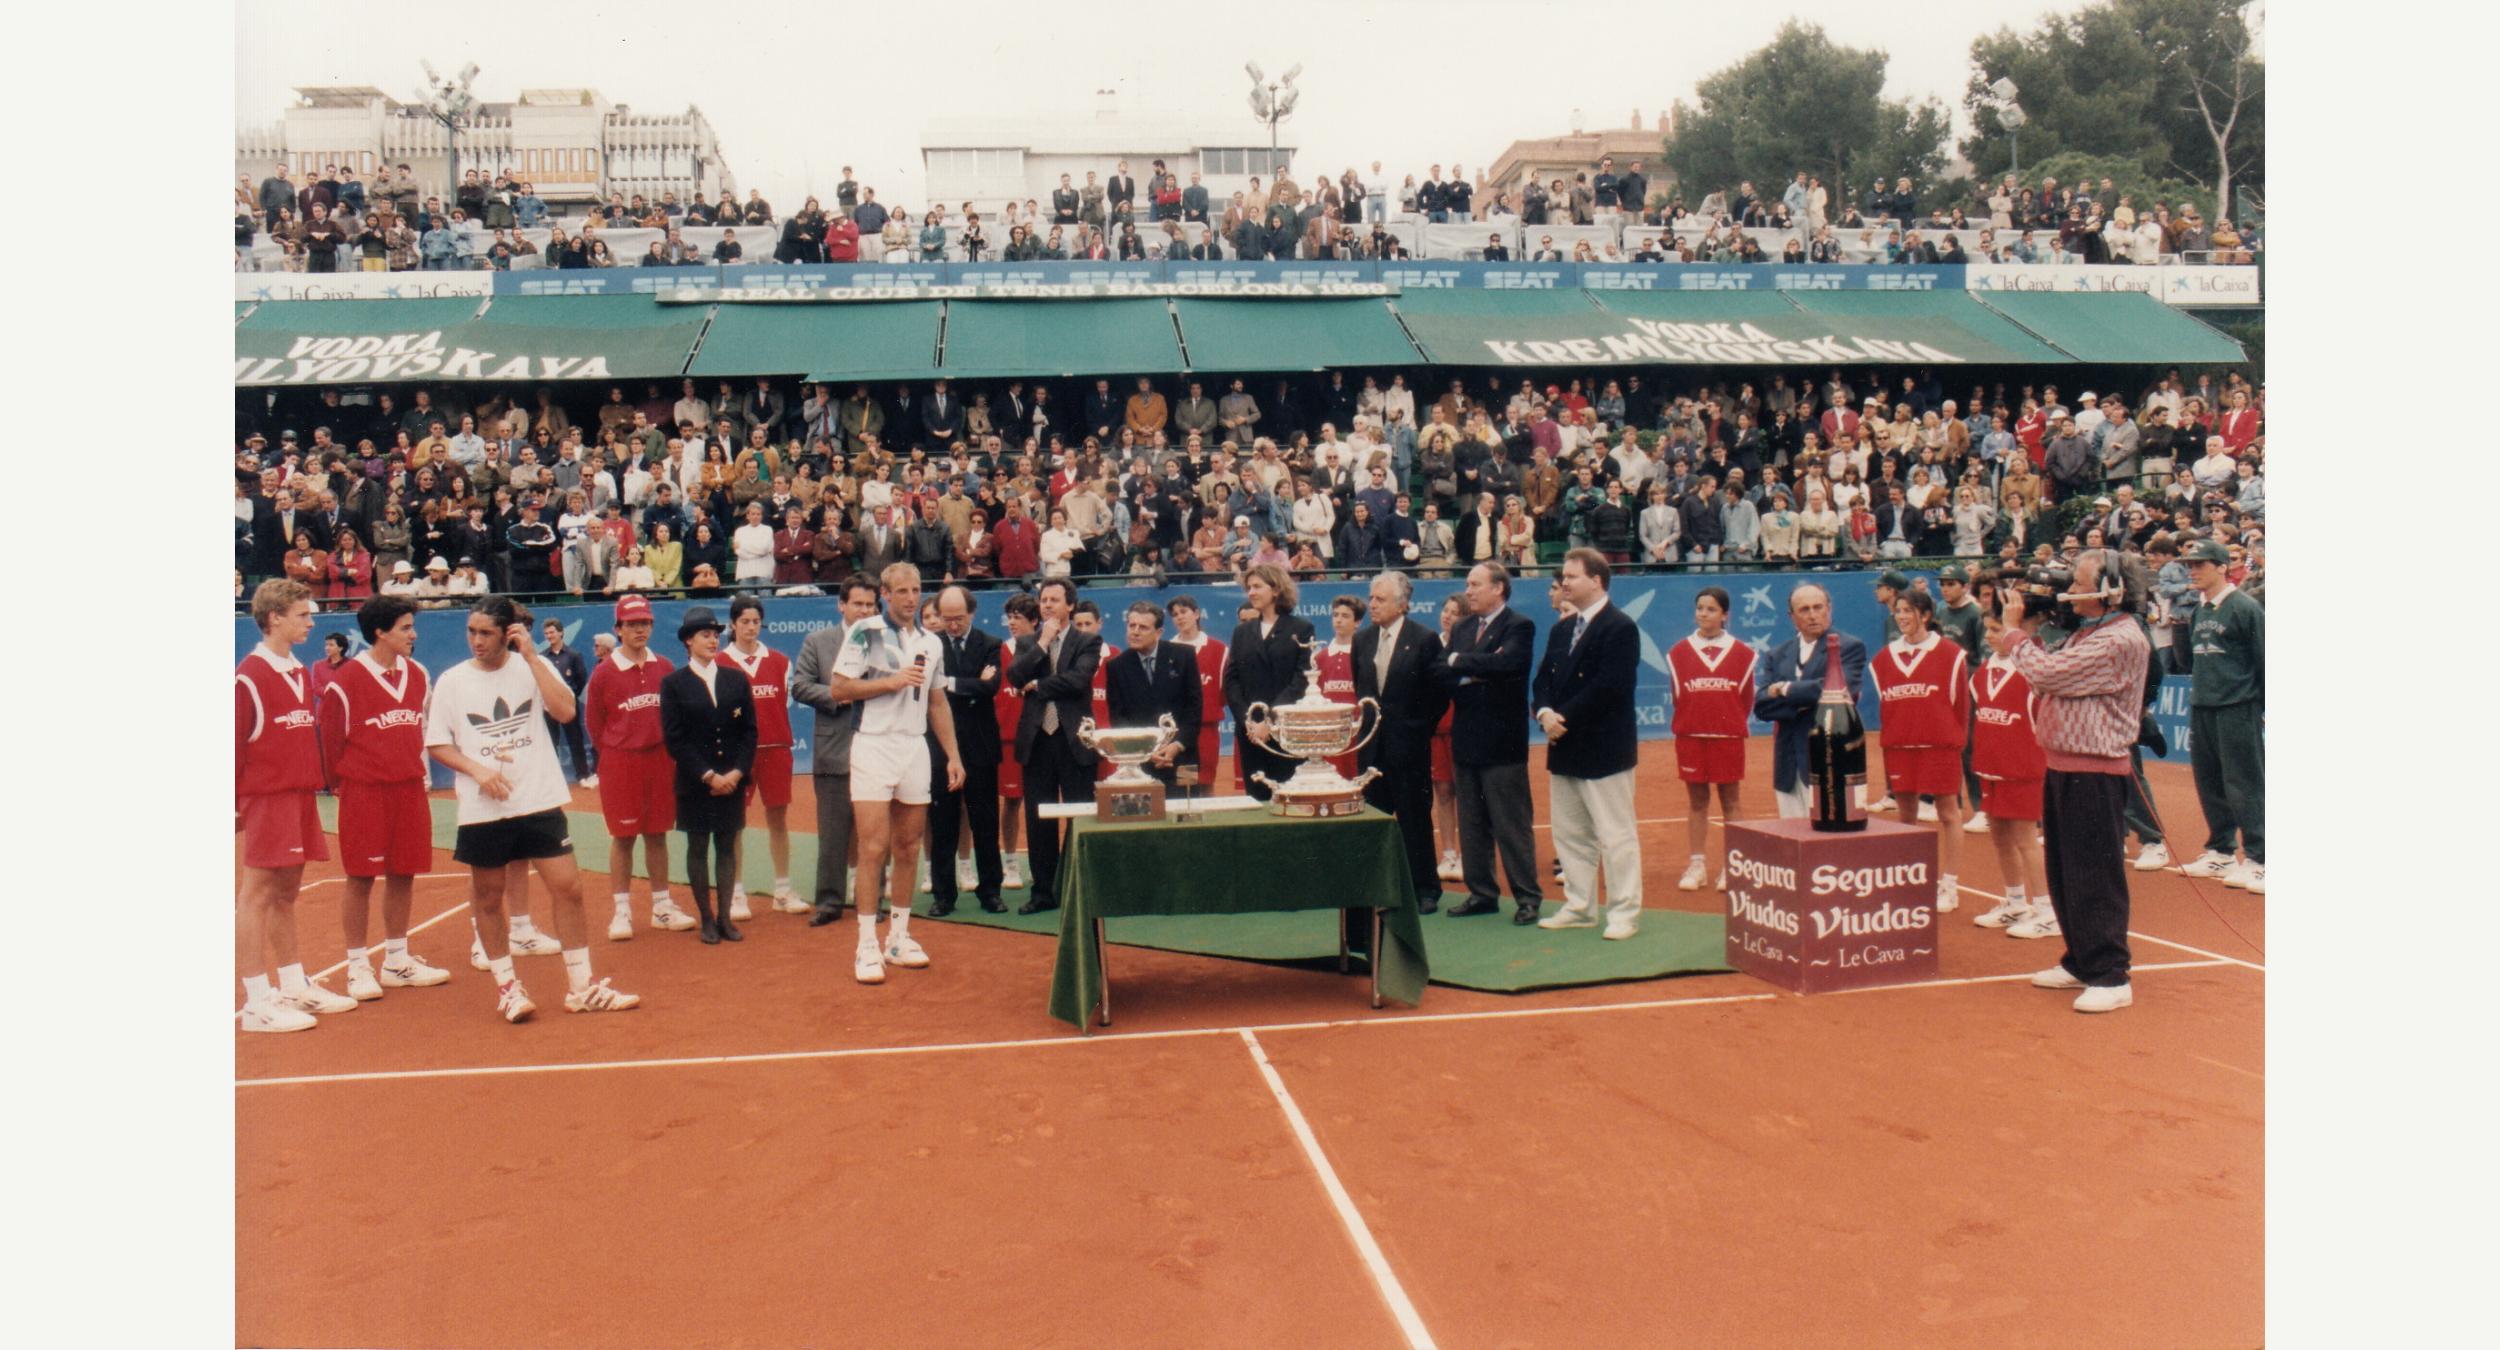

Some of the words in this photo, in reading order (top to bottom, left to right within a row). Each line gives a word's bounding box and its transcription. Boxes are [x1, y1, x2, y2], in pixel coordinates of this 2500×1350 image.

[521, 279, 606, 295] SEAT
[632, 276, 716, 293] SEAT
[1383, 271, 1460, 288] SEAT
[1484, 271, 1560, 289] SEAT
[1584, 272, 1659, 289] SEAT
[1680, 273, 1752, 290] SEAT
[1775, 274, 1845, 290] SEAT
[1866, 274, 1938, 290] SEAT
[718, 288, 816, 300] REAL
[829, 287, 919, 299] CLUB
[928, 286, 977, 298] DE
[986, 284, 1095, 297] TENIS
[1106, 283, 1314, 296] BARCELONA
[1318, 283, 1388, 295] 1899
[1628, 318, 1778, 344] VODKA
[287, 331, 442, 359] VODKA
[1485, 333, 1968, 364] KREMLYOVSKAYA
[768, 620, 834, 633] CORDOBA
[1728, 849, 1797, 891] Segura
[1811, 862, 1928, 897] Segura
[1728, 890, 1799, 936] Viudas
[1810, 902, 1931, 939] Viudas
[1839, 949, 1862, 968] Le
[1863, 945, 1905, 965] Cava
